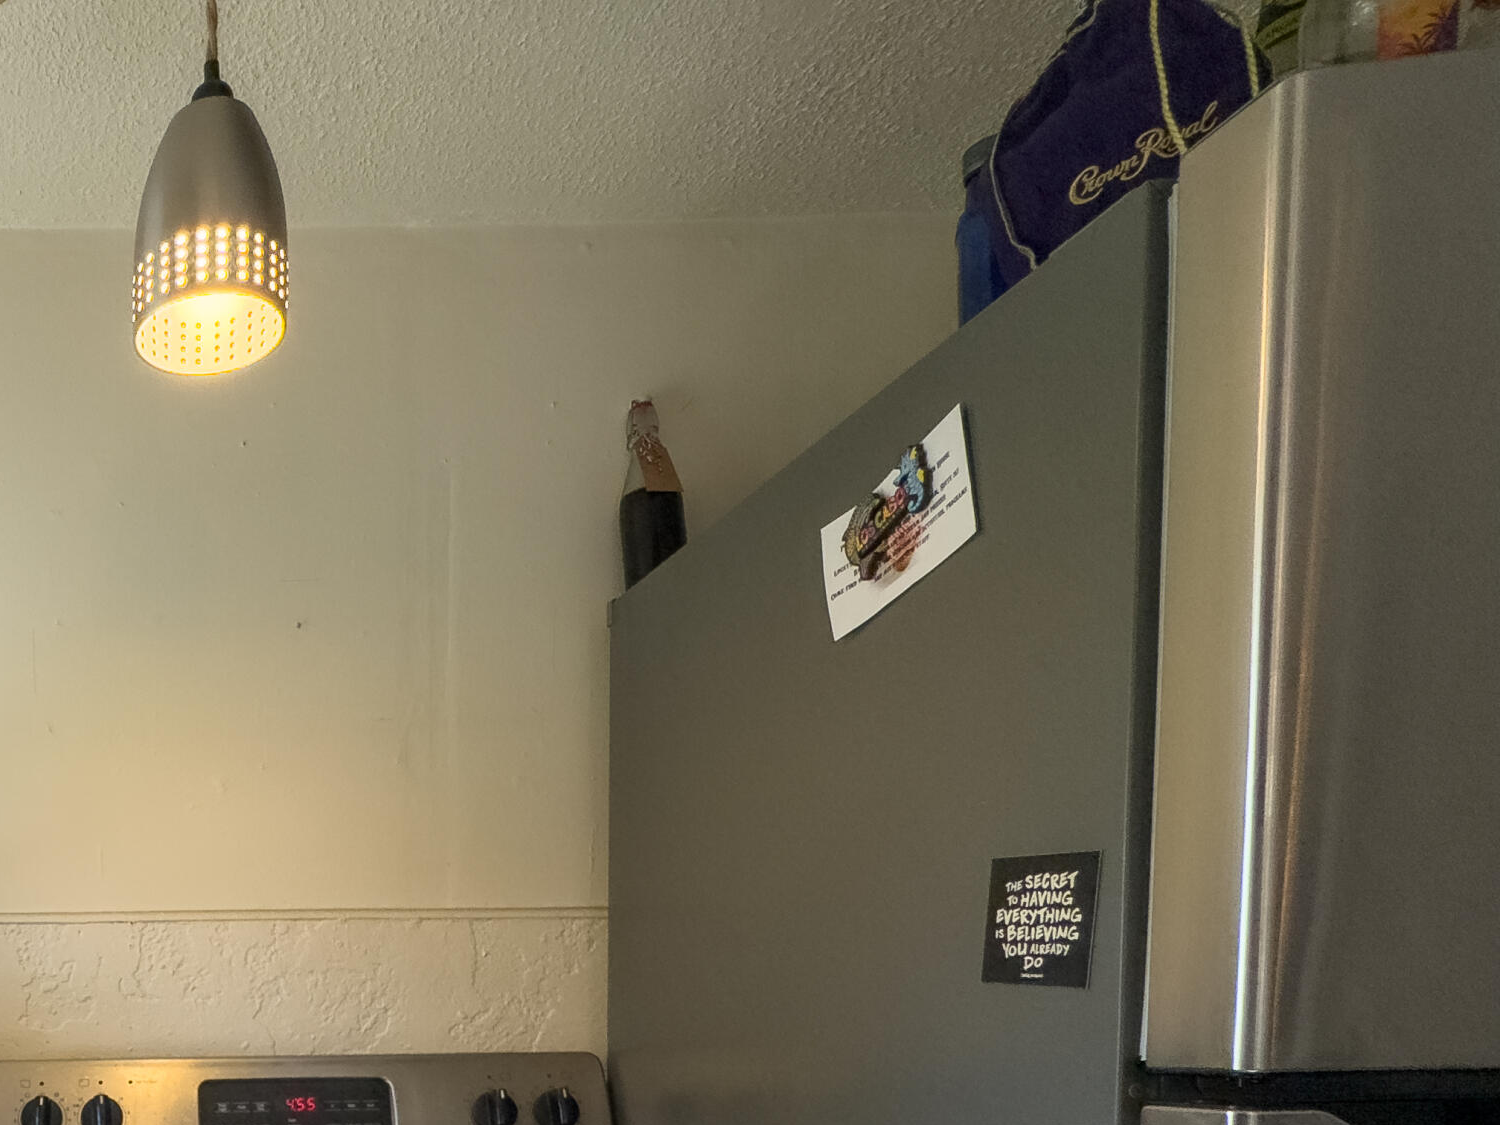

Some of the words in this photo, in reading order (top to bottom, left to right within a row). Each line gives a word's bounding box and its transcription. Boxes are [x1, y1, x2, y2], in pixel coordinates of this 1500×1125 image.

[1069, 155, 1140, 206] Crown
[1005, 880, 1023, 892] THE
[1025, 870, 1079, 890] SECRET
[1007, 895, 1018, 906] TO
[1020, 890, 1073, 907] HAVING
[996, 907, 1082, 925] EVERYTHING
[995, 929, 1004, 939] IS
[1007, 925, 1080, 942] BELIEVING
[1002, 943, 1027, 959] YOU
[1029, 943, 1070, 956] ALREADY
[1023, 957, 1044, 971] DO
